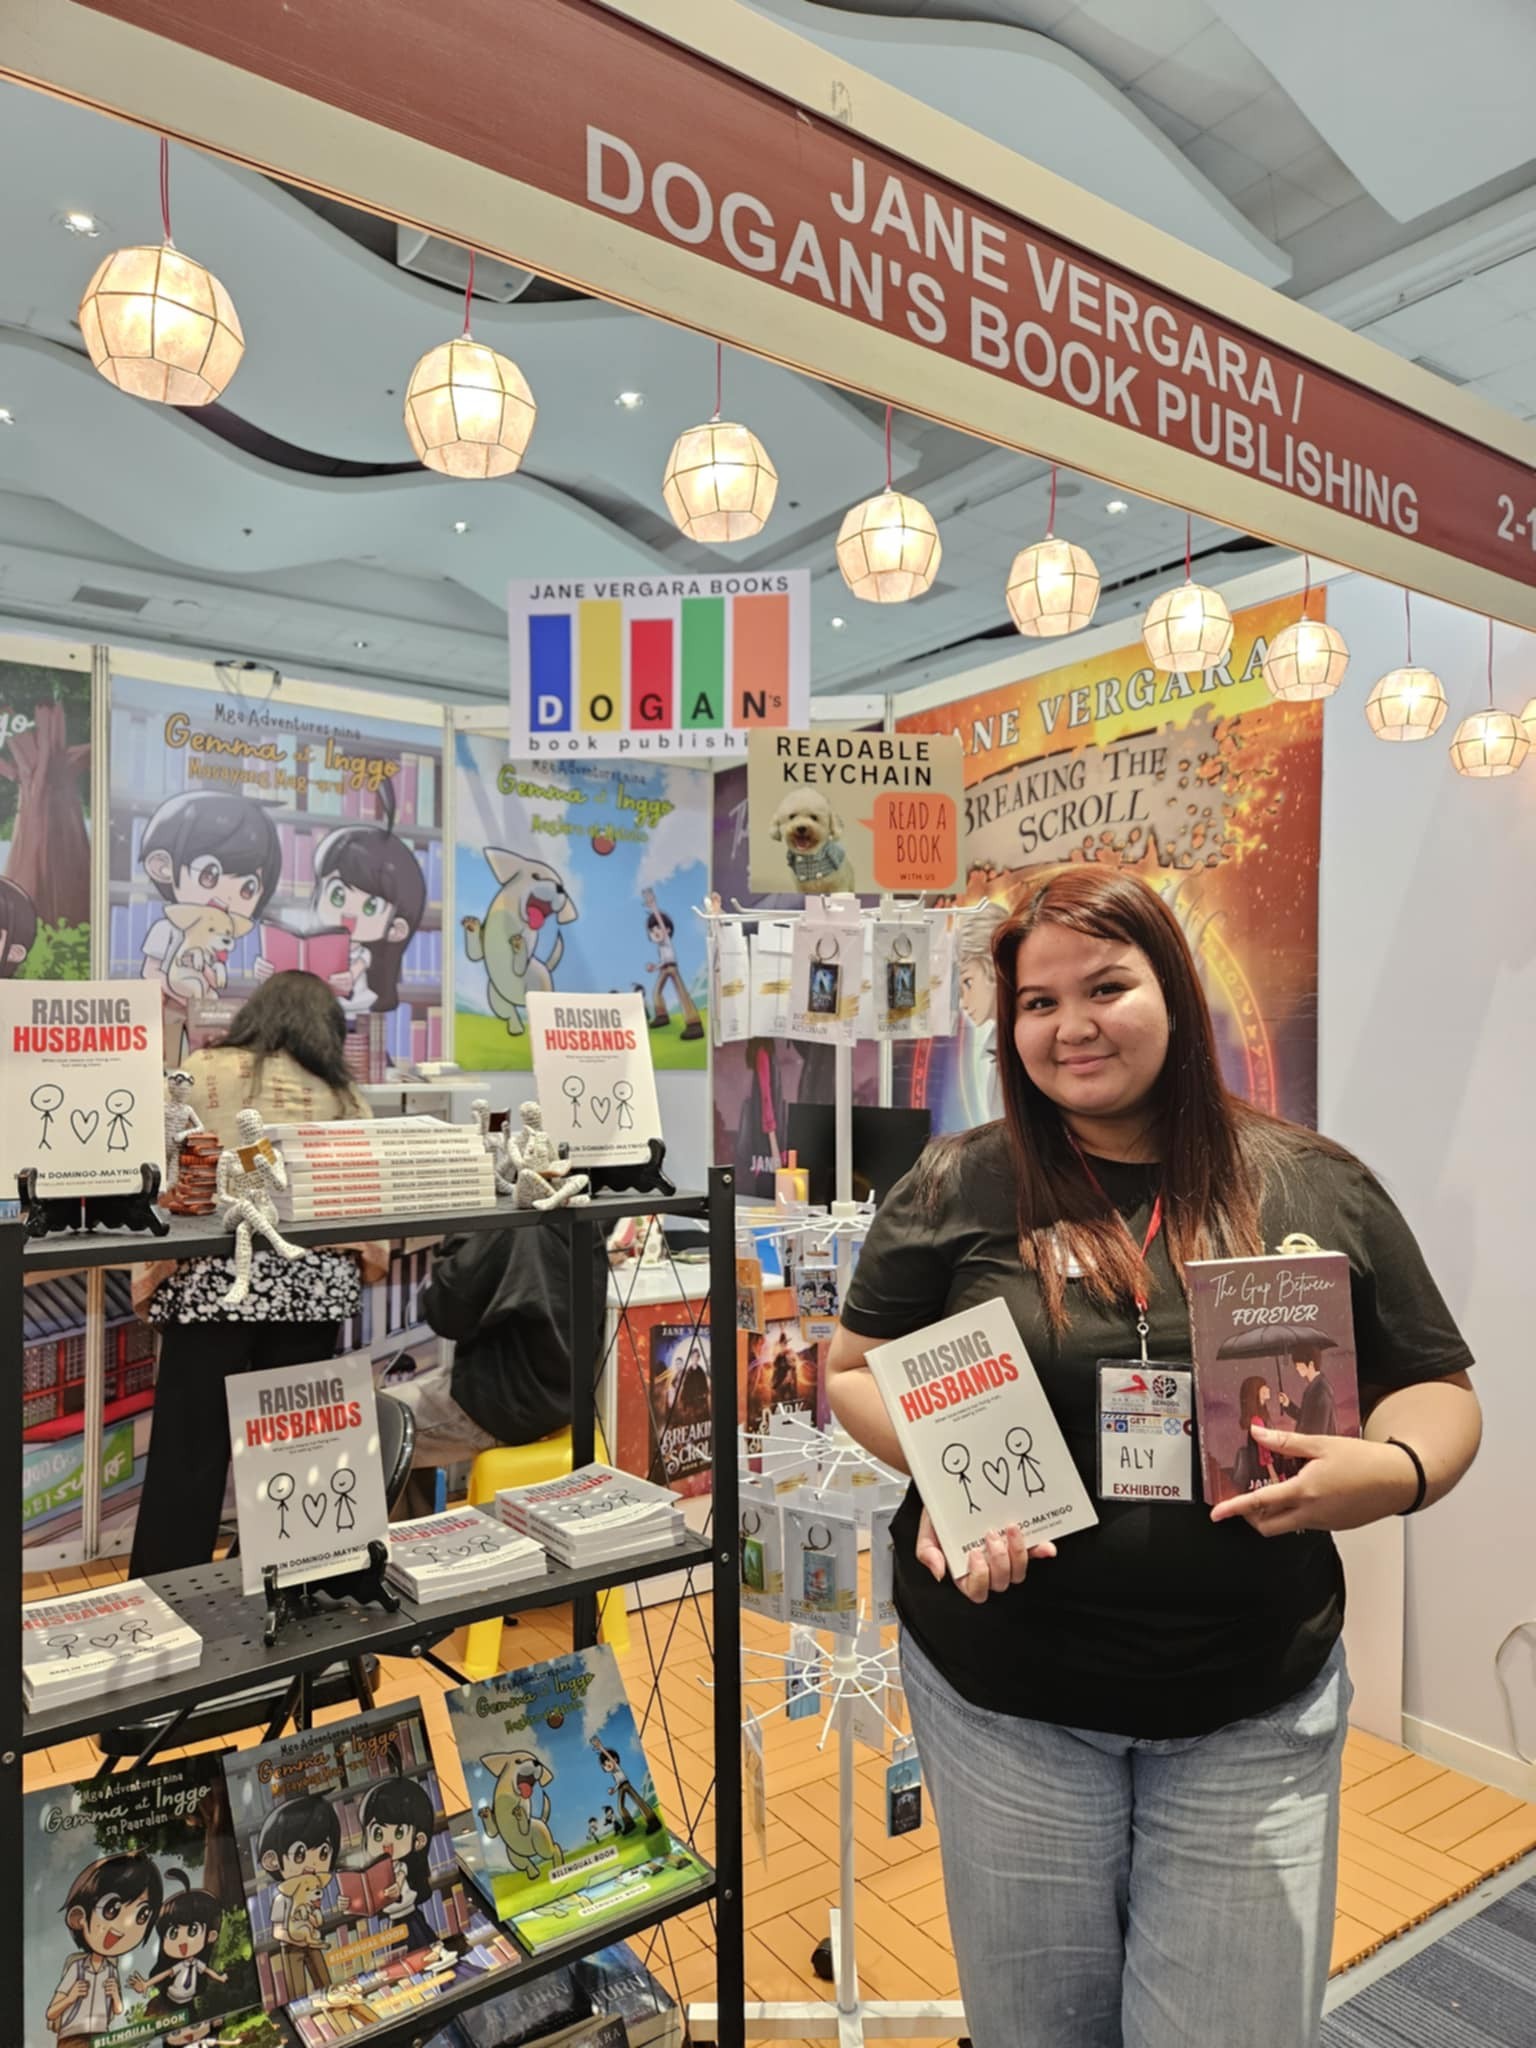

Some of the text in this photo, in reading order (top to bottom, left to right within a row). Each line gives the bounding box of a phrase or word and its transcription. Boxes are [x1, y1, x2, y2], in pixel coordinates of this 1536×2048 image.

[830, 158, 1304, 425] JANE VERGARA /
[586, 125, 1419, 535] DOGAN'S BOOK PUBLISHING
[530, 576, 789, 601] JANE VERGARA BOOKS
[214, 703, 245, 726] Mga
[248, 708, 331, 737] Adventures
[164, 711, 287, 763] Gemma
[325, 737, 400, 793] Inggo
[529, 736, 598, 752] book
[776, 736, 931, 761] READABLE
[783, 762, 932, 786] KEYCHAIN
[496, 762, 590, 805] Gemma
[616, 782, 676, 828] Inggo
[888, 801, 946, 831] READ A
[1018, 788, 1150, 854] SCROLL
[897, 834, 942, 864] BOOK
[900, 873, 936, 882] WITH US
[31, 998, 131, 1025] RAISING
[554, 1007, 622, 1029] RAISING
[13, 1025, 148, 1053] HUSBANDS
[544, 1029, 637, 1051] HUSBANDS
[1210, 1270, 1335, 1308] The Gap Between
[1232, 1303, 1319, 1326] FOREVER
[901, 1329, 994, 1388] RAISING
[258, 1377, 345, 1416] RAISING
[899, 1352, 1019, 1424] HUSBANDS
[245, 1401, 363, 1447] HUSBANDS
[1120, 1446, 1154, 1469] ALY
[524, 1474, 613, 1504] HUSBANDS
[1113, 1483, 1180, 1497] EXHIBITOR
[26, 1593, 121, 1619] RAISING
[475, 1693, 537, 1719] Gemma
[554, 1671, 596, 1699] Inggo
[258, 1752, 332, 1785] Gemma
[351, 1728, 400, 1761] Inggo
[280, 1743, 299, 1757] Mga
[300, 1729, 350, 1751] Adventures
[81, 1773, 184, 1803] Mga Adventures nina
[46, 1785, 212, 1833] Gemma at Inggo
[105, 1812, 169, 1836] sa Paaralan
[551, 1847, 616, 1880] BILINGUAL BOOK
[93, 2011, 186, 2048] BILINGUAL BOOK
